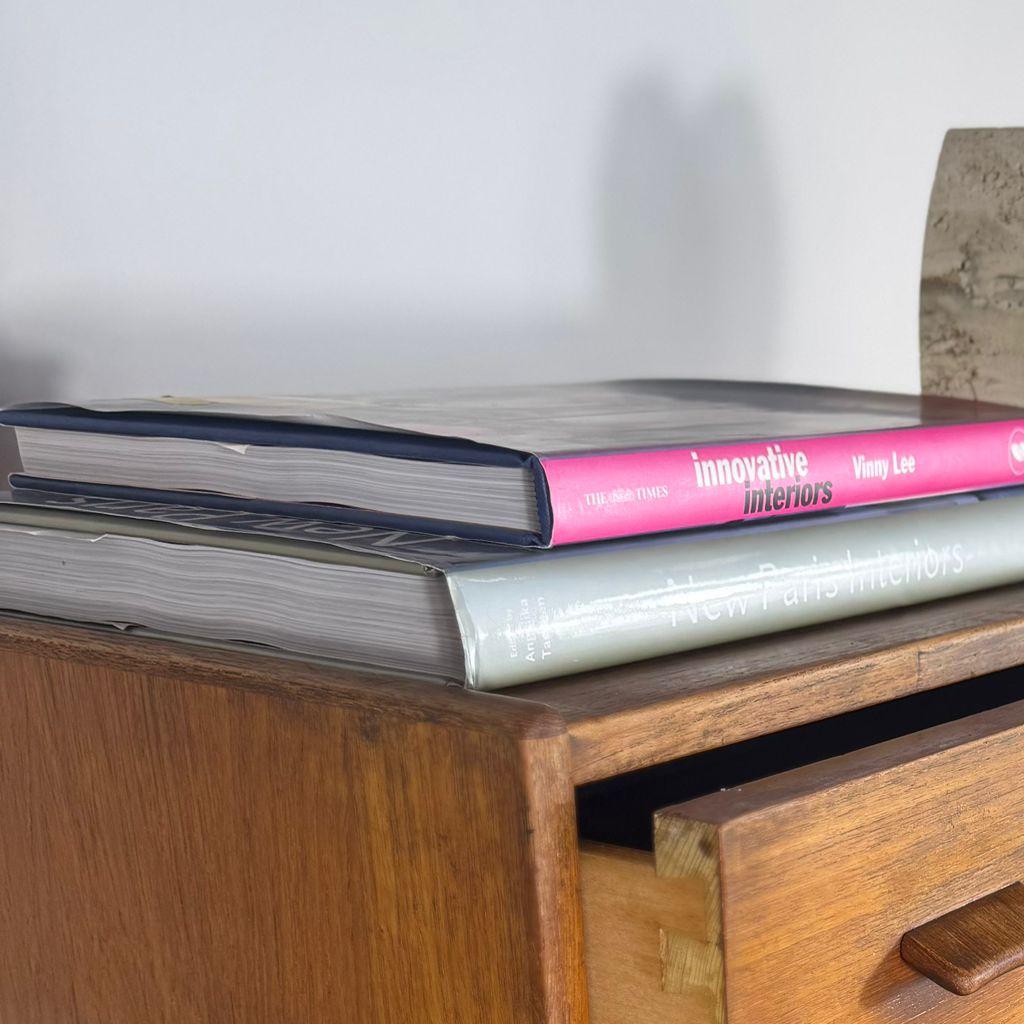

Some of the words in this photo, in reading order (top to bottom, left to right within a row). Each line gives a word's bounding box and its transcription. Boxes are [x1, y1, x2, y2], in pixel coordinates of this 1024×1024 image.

[691, 444, 809, 487] innovative
[853, 455, 889, 480] Vinny
[892, 451, 916, 475] Lee
[584, 491, 606, 506] THE
[635, 485, 669, 501] TIMES
[743, 475, 833, 514] interiors
[667, 575, 748, 628] New
[759, 555, 838, 611] Paris
[847, 539, 964, 594] Interiors
